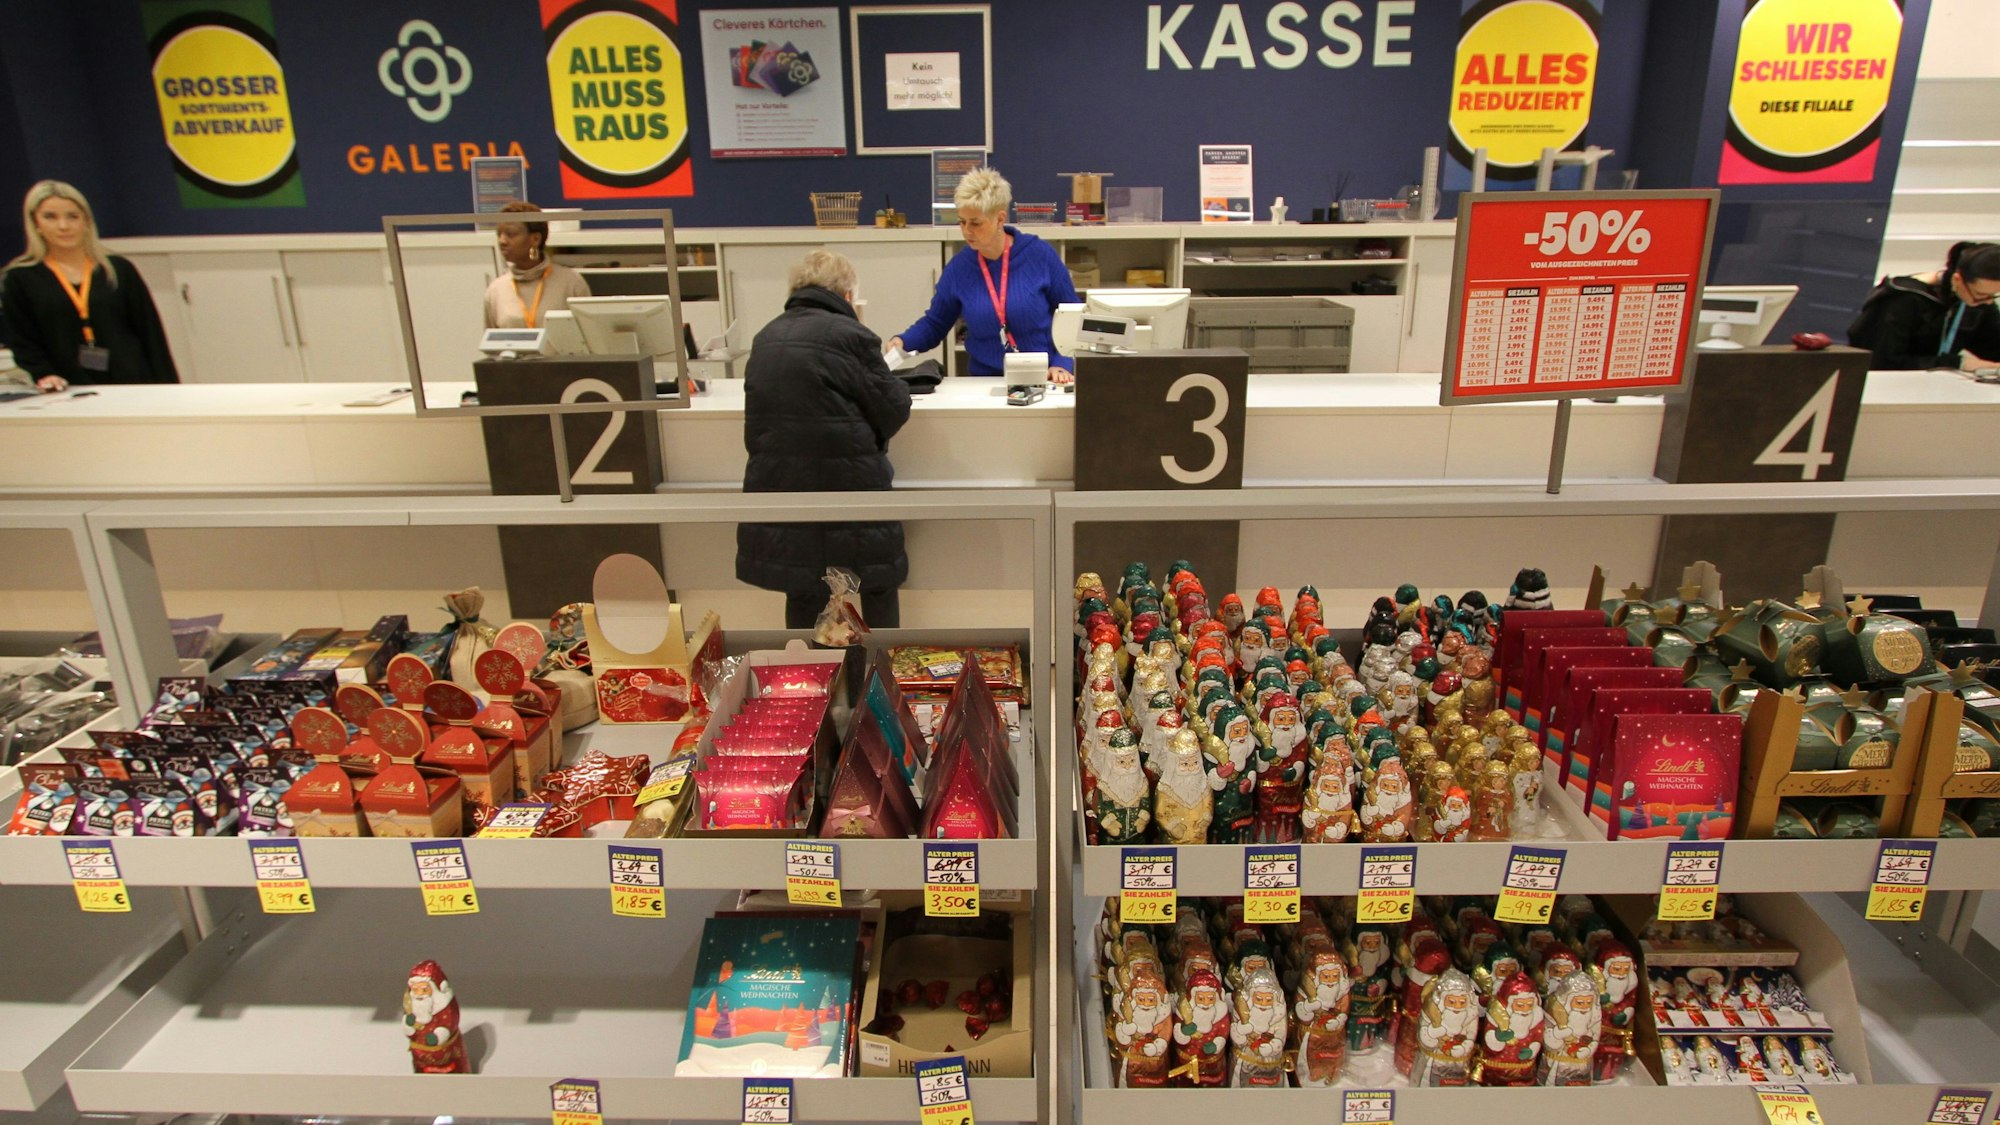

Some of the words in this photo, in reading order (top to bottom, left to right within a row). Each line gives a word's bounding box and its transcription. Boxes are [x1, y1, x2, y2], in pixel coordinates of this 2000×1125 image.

[713, 18, 765, 30] Cleveres
[768, 17, 826, 29] Kärtchen.
[1146, 0, 1415, 70] KASSE
[1785, 23, 1852, 54] WIR
[569, 44, 661, 75] ALLES
[912, 62, 933, 70] Kein
[1461, 52, 1589, 86] ALLES
[1739, 58, 1886, 82] SCHLIESSEN
[163, 75, 278, 98] GROSSER
[572, 78, 665, 109] MUSS
[1459, 91, 1585, 111] REDUZIERT
[1760, 99, 1800, 114] DIESE
[1803, 98, 1854, 113] FILIALE
[173, 119, 284, 136] ABVERKAUF
[574, 112, 668, 141] RAUS
[1524, 209, 1651, 256] -50%
[1531, 261, 1548, 269] VOM
[1548, 260, 1616, 269] AUSGEZEICHNETEN
[560, 378, 634, 485] 2
[1160, 373, 1229, 485] 3
[1753, 369, 1840, 480] 4
[1650, 758, 1695, 773] Lindt
[1807, 778, 1855, 794] Lindt
[812, 845, 833, 853] PREIS
[1880, 871, 1909, 882] -50%
[628, 886, 660, 894] ZAHLEN
[793, 889, 820, 901] 2,99
[826, 892, 836, 901] €
[1518, 890, 1552, 898] ZAHLEN
[83, 891, 110, 904] 1,25
[115, 893, 126, 905] €
[298, 893, 310, 905] €
[463, 894, 474, 906] €
[617, 896, 652, 908] 1,85
[650, 900, 662, 911] €
[931, 893, 965, 911] 3,50
[965, 898, 976, 910] €
[1663, 898, 1698, 913] 3,65
[1701, 900, 1713, 912] €
[1874, 897, 1908, 914] 1,85
[1909, 900, 1920, 912] €
[1126, 902, 1156, 916] 1,99
[1162, 904, 1172, 916] €
[1249, 900, 1281, 915] 2,30
[1286, 903, 1297, 915] €
[1362, 900, 1398, 916] 1,50
[1399, 903, 1410, 915] €
[1538, 905, 1549, 917] €
[740, 991, 799, 999] WEIHNACHTEN
[920, 1067, 941, 1076] ALTER
[942, 1065, 963, 1073] PREIS
[956, 1076, 963, 1084] €
[1775, 1095, 1809, 1103] ZAHLEN
[937, 1104, 967, 1113] ZAHLEN
[1806, 1110, 1820, 1124] €
